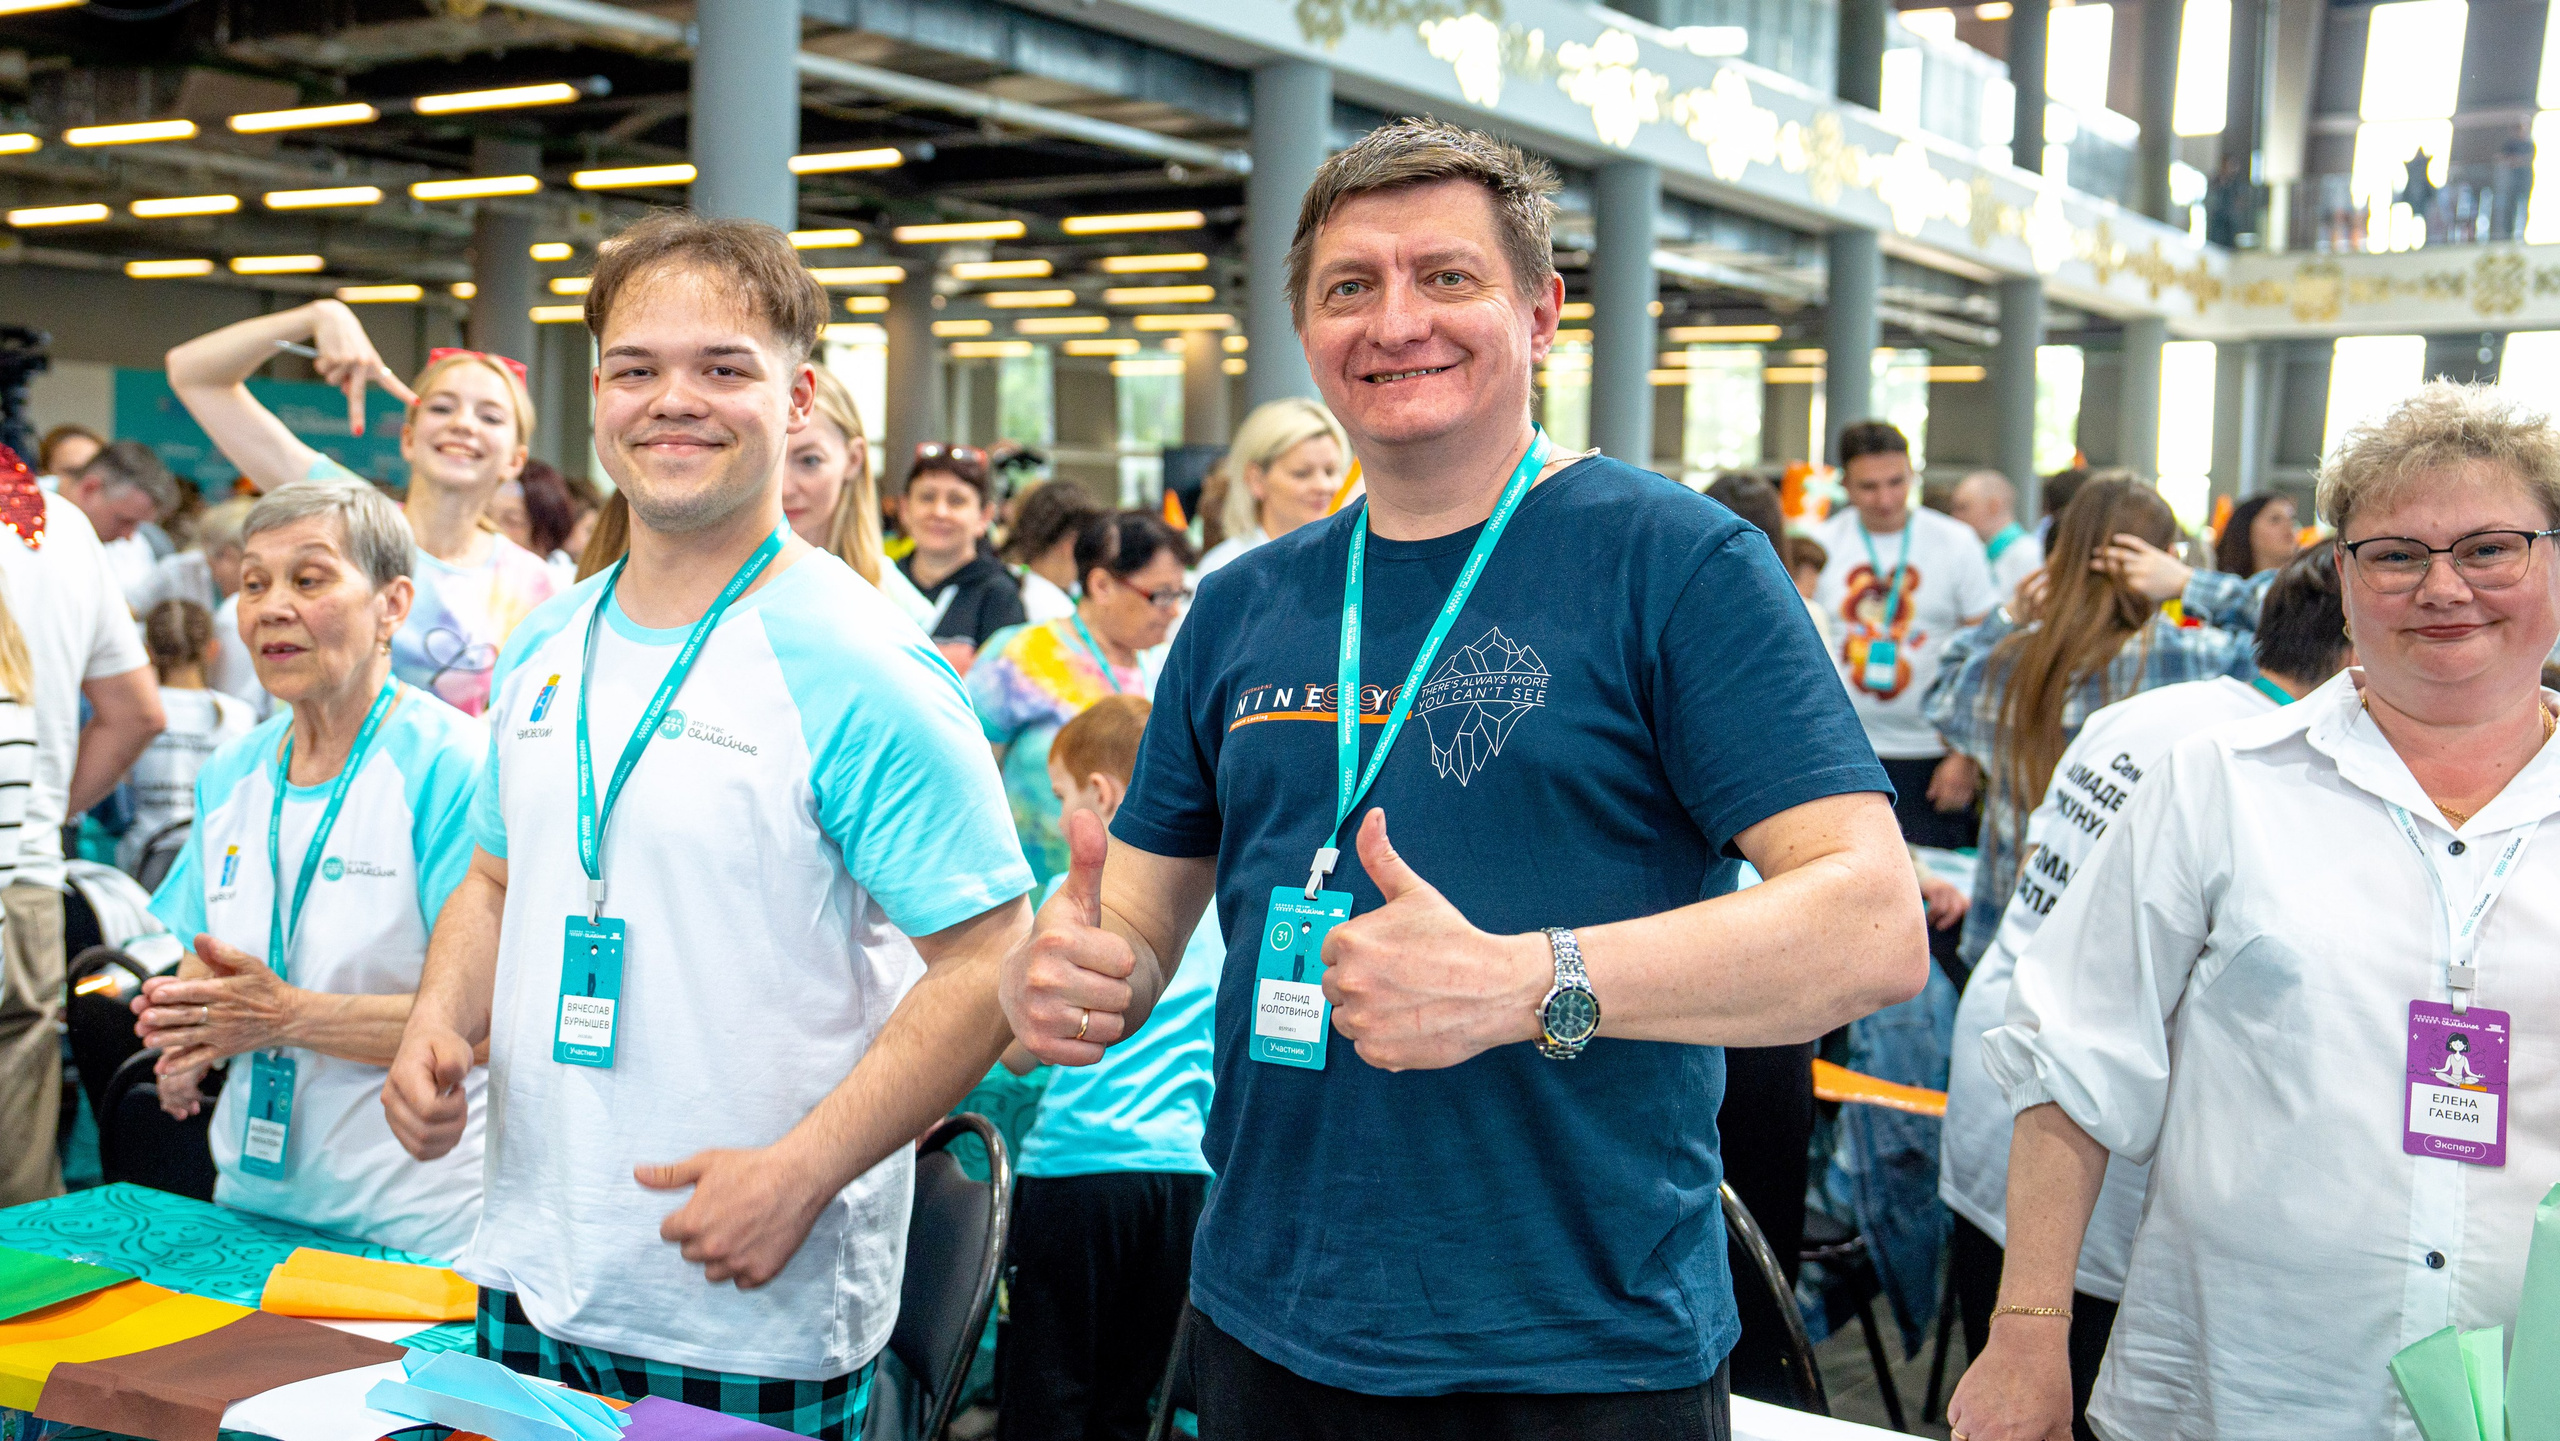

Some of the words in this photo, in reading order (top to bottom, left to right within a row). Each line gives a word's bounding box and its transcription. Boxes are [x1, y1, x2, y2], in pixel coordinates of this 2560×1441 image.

[1421, 679, 1459, 698] THERE'S
[1460, 675, 1507, 687] ALWAYS
[1510, 675, 1549, 688] MORE
[1418, 693, 1446, 712] YOU
[1452, 686, 1504, 701] CAN'T
[1512, 688, 1547, 703] SEE
[687, 727, 758, 756] семейное
[1277, 930, 1289, 942] 31
[1273, 991, 1310, 1005] ЛЕОНИД
[567, 1002, 610, 1016] ВЯЧЕСЛАВ
[1260, 1003, 1320, 1019] КОЛОТВИНОВ
[564, 1016, 610, 1030] БУРНЫШЕВ
[570, 1046, 598, 1057] Участник
[1270, 1042, 1305, 1056] Участник
[2432, 1093, 2478, 1109] ЕЛЕНА
[2429, 1107, 2479, 1124] ГАЕВАЯ
[2434, 1139, 2476, 1154] Эксперт
